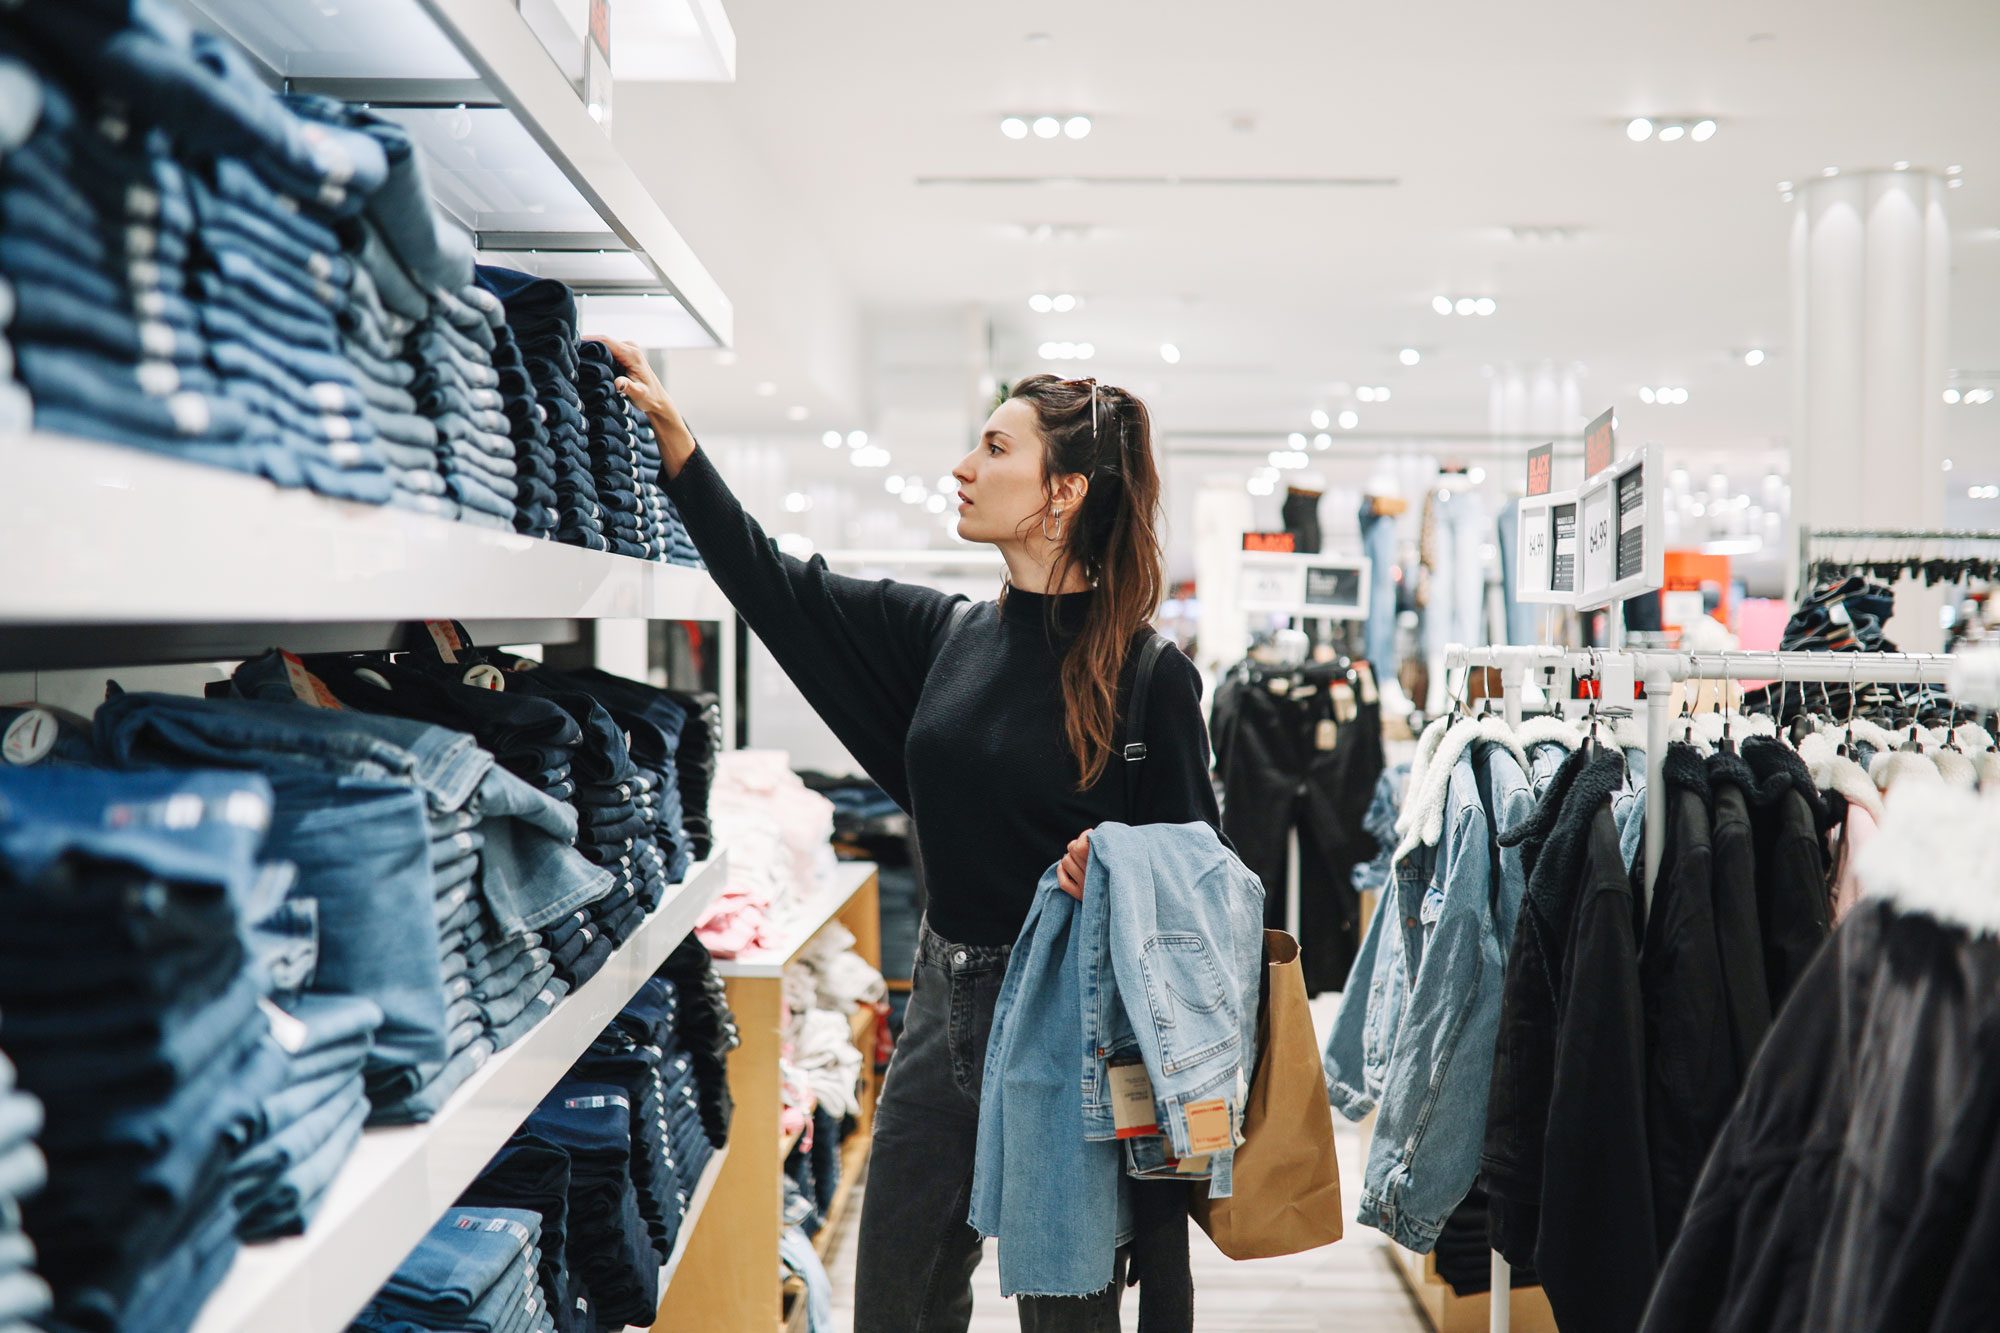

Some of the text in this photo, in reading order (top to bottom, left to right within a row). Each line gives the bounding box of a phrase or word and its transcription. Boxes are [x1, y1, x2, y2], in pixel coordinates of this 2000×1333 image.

[1529, 453, 1550, 476] BLACK
[1529, 532, 1544, 556] 64.99
[1590, 519, 1607, 553] 64.99
